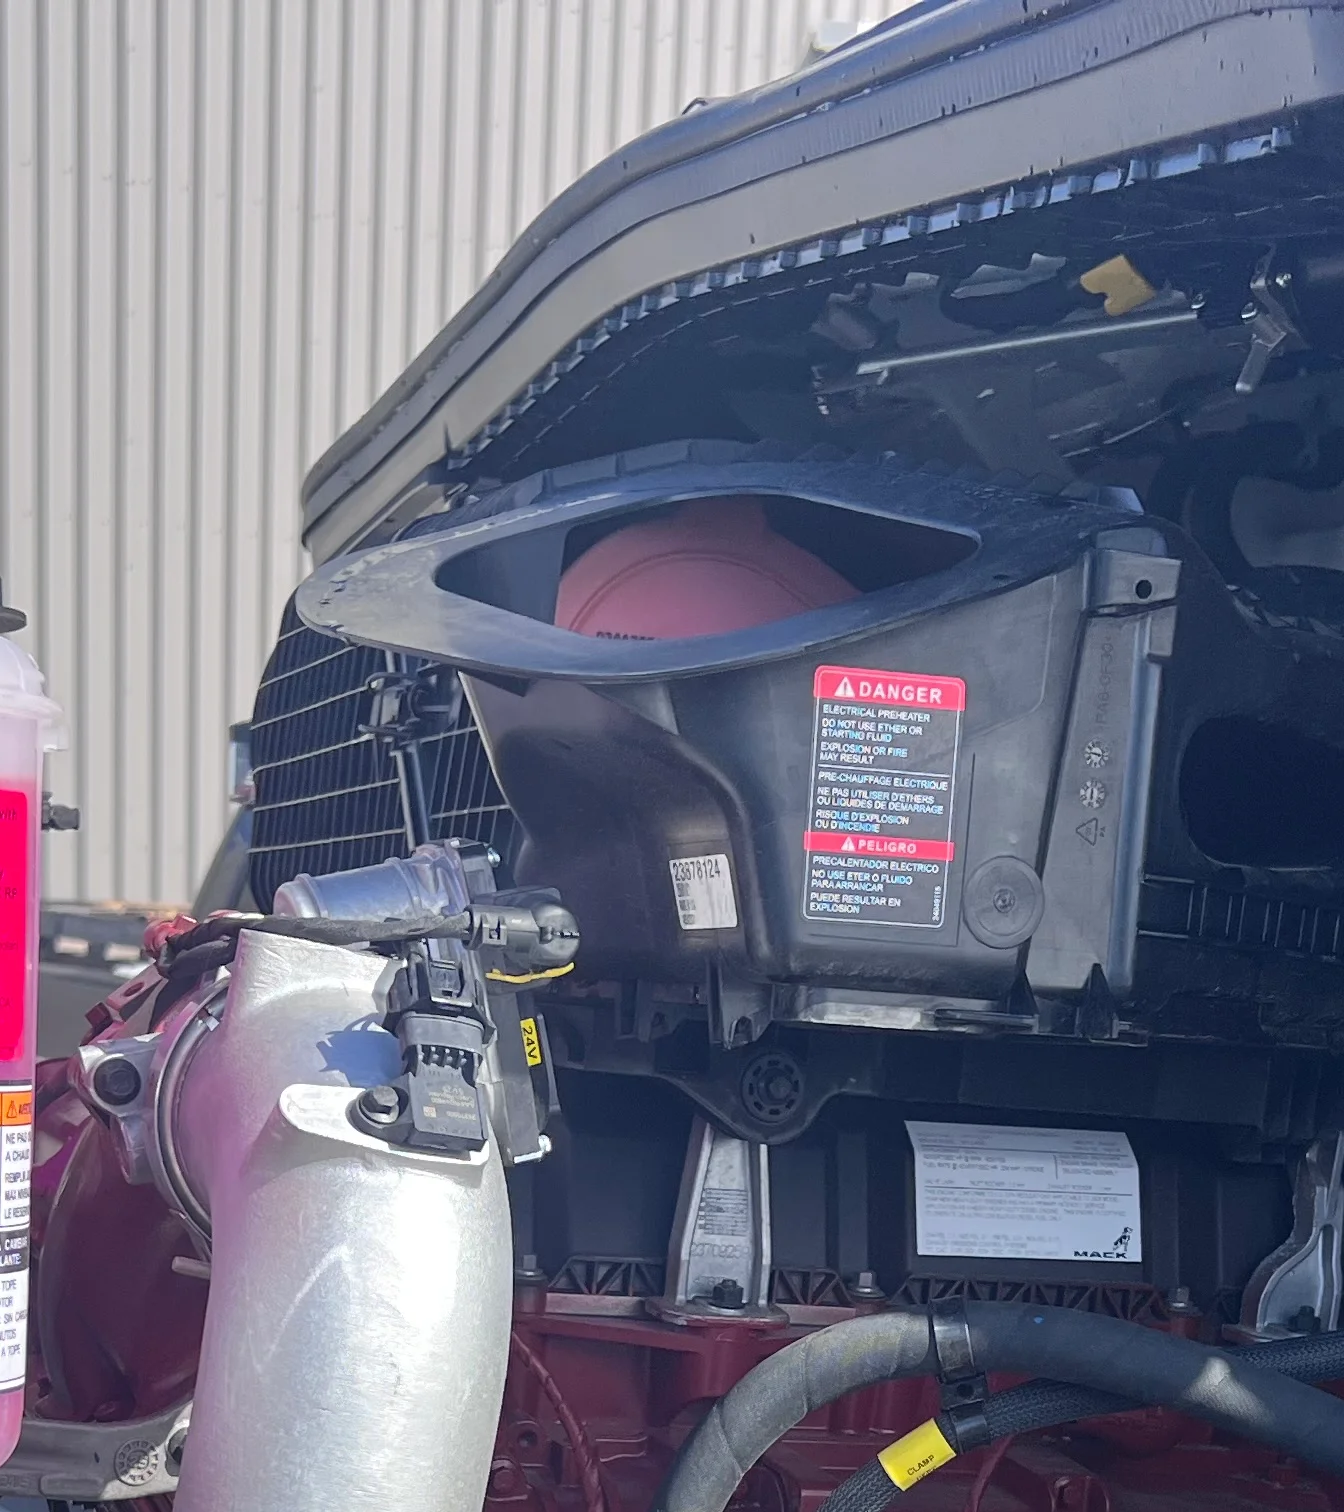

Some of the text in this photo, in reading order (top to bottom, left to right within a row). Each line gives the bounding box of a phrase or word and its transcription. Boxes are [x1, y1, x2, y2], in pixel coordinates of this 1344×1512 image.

[859, 682, 943, 703] DANGER
[823, 705, 930, 722] ELECTRICAL PREHEATER
[822, 719, 922, 735] DO NOT USE ETHER OR
[822, 730, 892, 742] STARTING FLUID
[821, 742, 907, 757] EXPLOSION OR FIRE
[820, 752, 874, 764] MAY RESULT
[818, 772, 891, 785] PRE-CHAUFFAGE
[818, 787, 830, 796] NE
[832, 788, 848, 797] PAS
[851, 790, 889, 800] UTILISER
[817, 797, 830, 805] OU
[832, 798, 872, 808] LIQUIDES
[874, 801, 887, 809] DE
[816, 810, 849, 820] RISQUE
[815, 820, 829, 829] OU
[858, 839, 916, 853] PELIGRO
[813, 856, 888, 869] PRECALENTADOR
[812, 870, 825, 878] NO
[828, 871, 845, 880] USE
[873, 874, 879, 882] O
[881, 874, 912, 885] FLUIDO
[812, 880, 883, 892] PARA ARRANCAR
[811, 893, 901, 906] PUEDE RESULTAR EN
[523, 1026, 538, 1058] 24V
[1074, 1251, 1128, 1259] MACK
[907, 1454, 934, 1475] CLAMP
